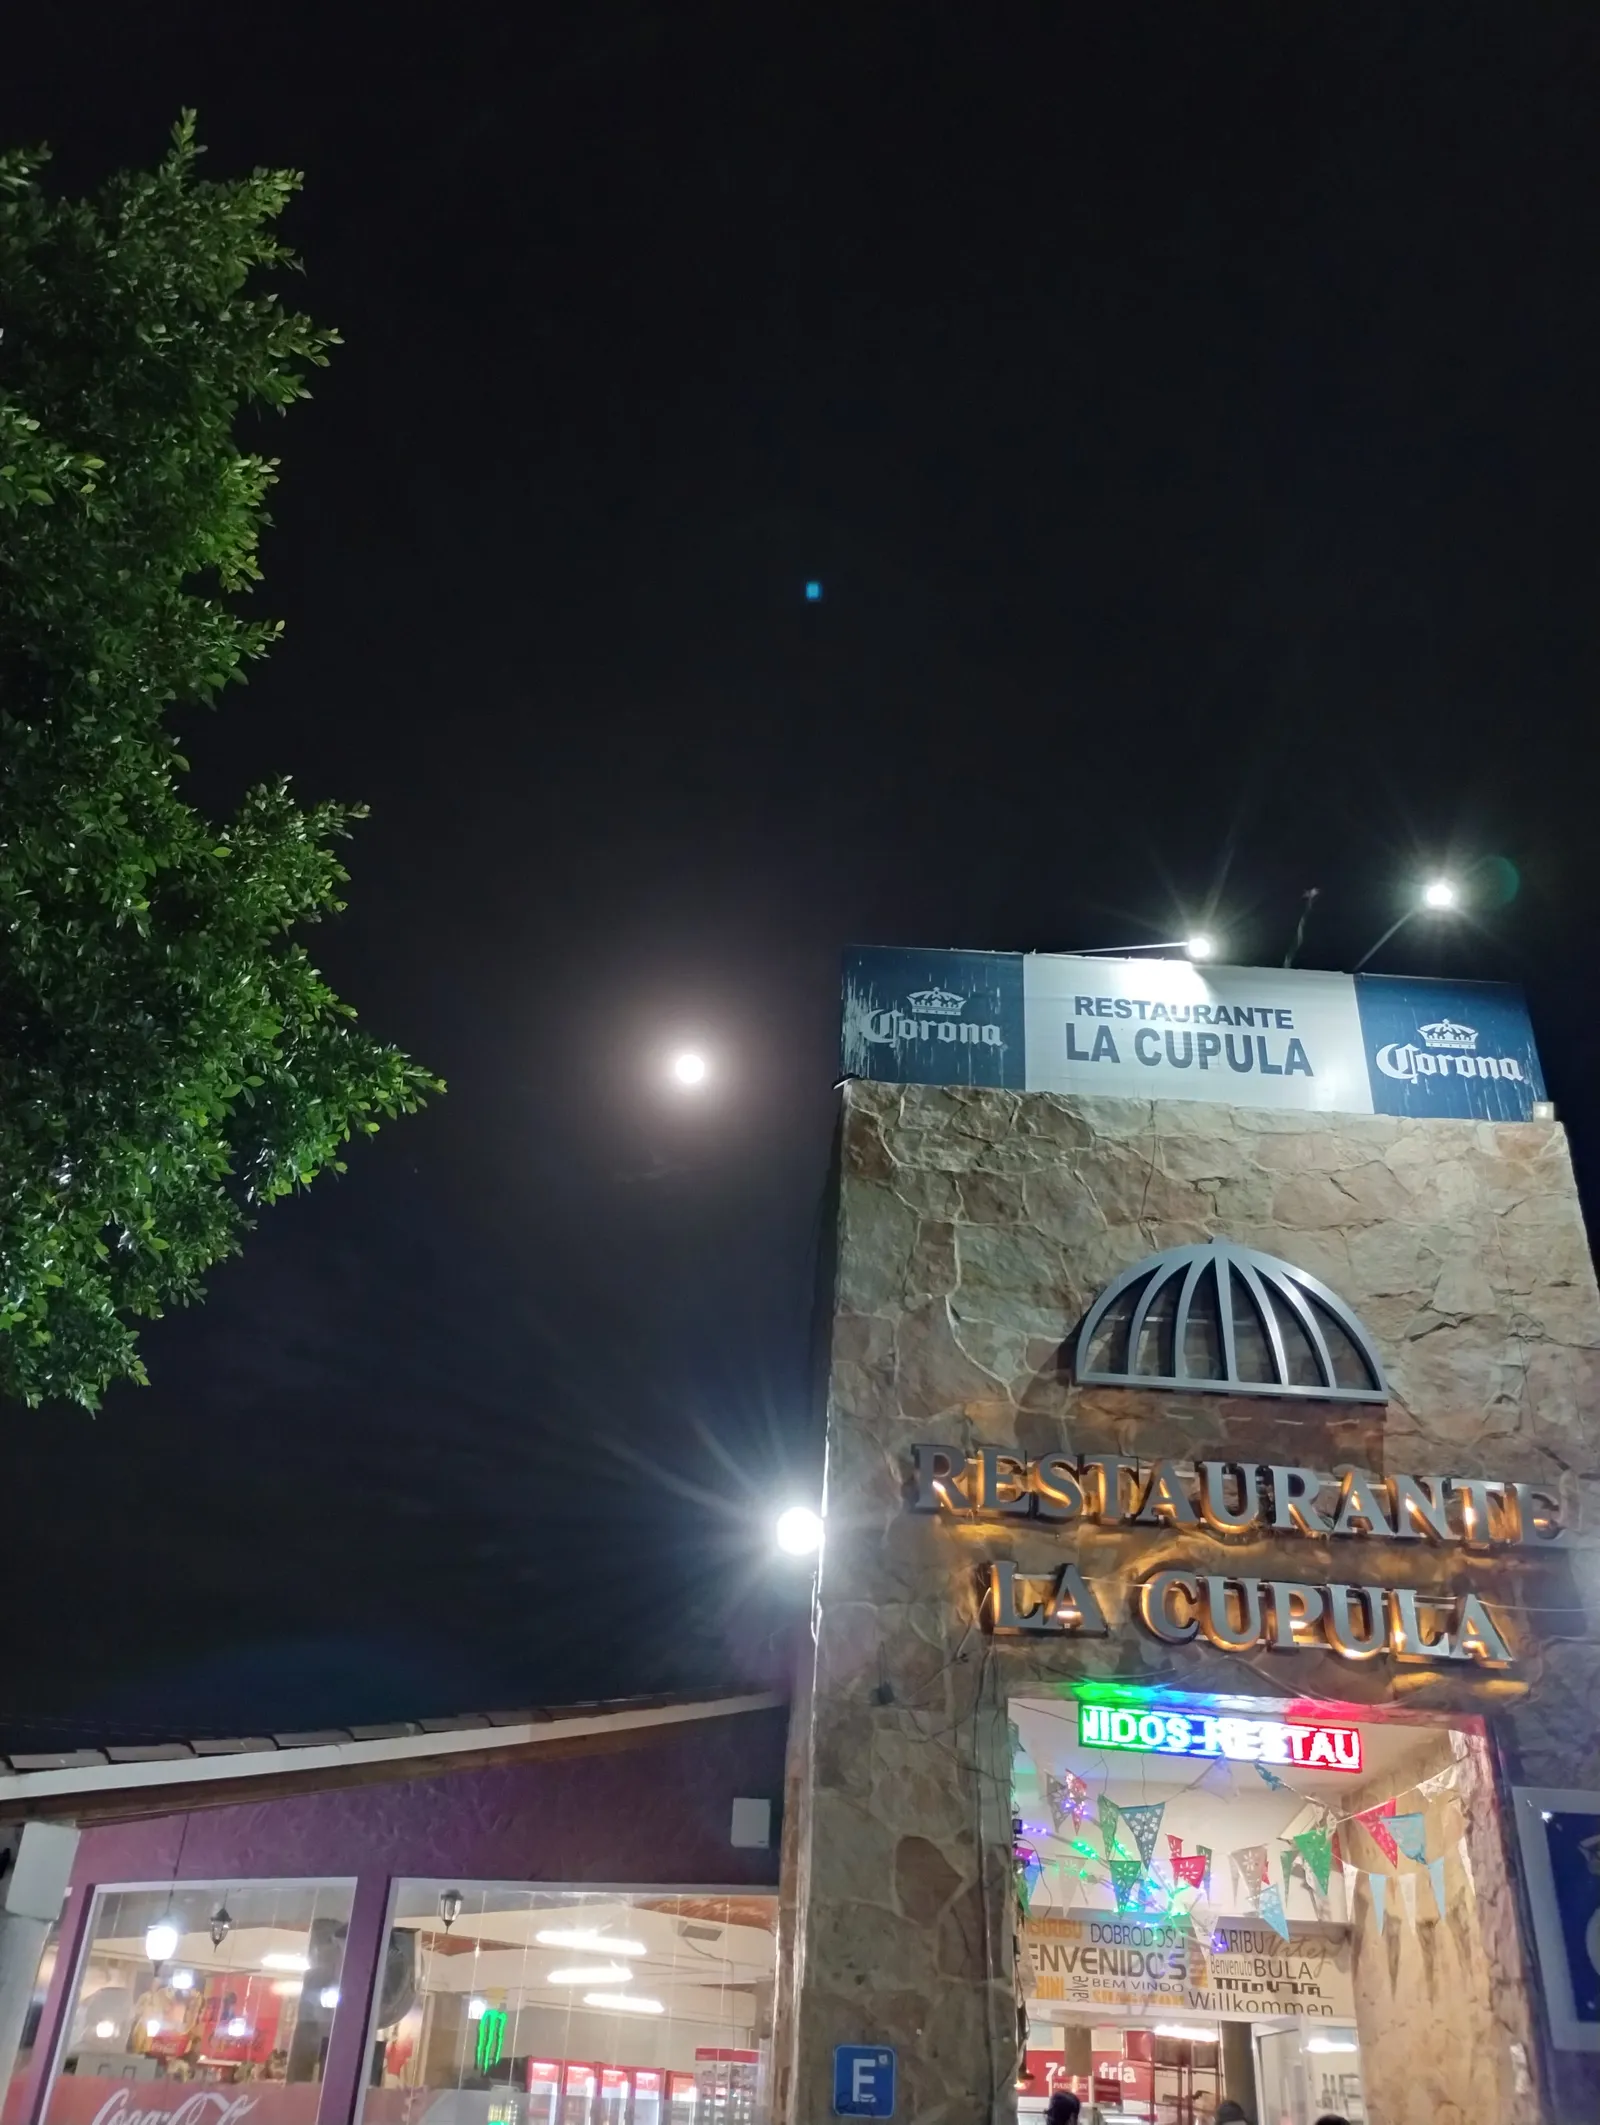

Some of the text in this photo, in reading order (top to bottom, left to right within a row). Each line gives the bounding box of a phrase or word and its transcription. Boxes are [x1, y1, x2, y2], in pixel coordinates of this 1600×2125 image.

[859, 1008, 1003, 1048] Corona
[1074, 995, 1294, 1030] RESTAURANTE
[1065, 1022, 1315, 1077] LA CUPULA
[1376, 1043, 1525, 1085] Corona
[911, 1444, 1567, 1549] RESTAURANTE
[989, 1560, 1518, 1664] LA CUPULA
[1028, 1943, 1187, 1980] NVENIDOS
[1254, 1958, 1314, 1980] BULA
[1092, 1978, 1184, 1993] BEM VINDO
[1188, 1991, 1335, 2017] Willkommen
